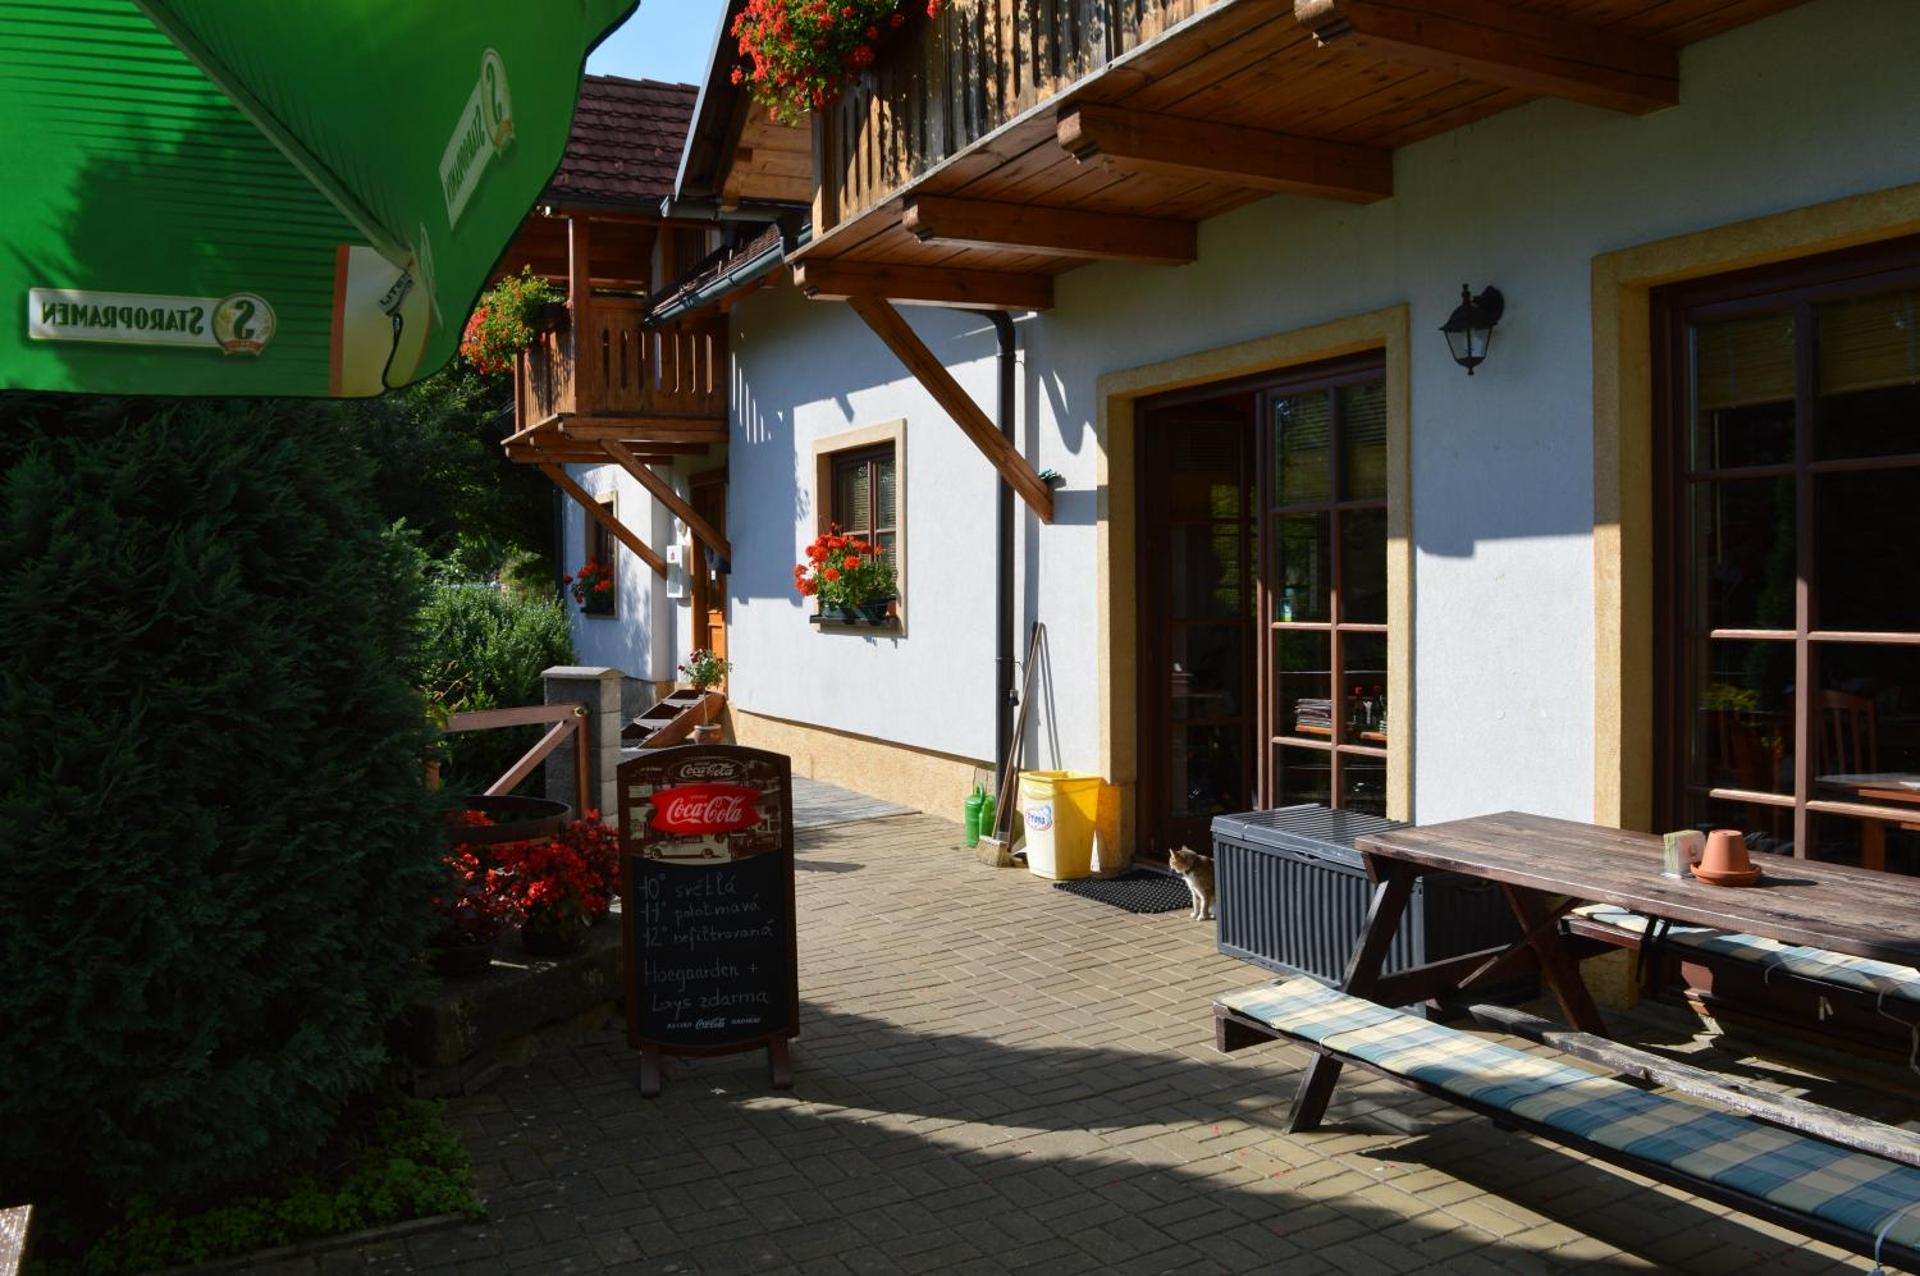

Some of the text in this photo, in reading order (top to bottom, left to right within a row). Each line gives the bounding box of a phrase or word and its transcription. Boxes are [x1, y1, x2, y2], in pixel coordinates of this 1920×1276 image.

[680, 762, 736, 778] Coca-Cola
[666, 795, 746, 825] Coca-Cola
[644, 955, 740, 993] Hoegaarden
[697, 988, 769, 1009] zdarma
